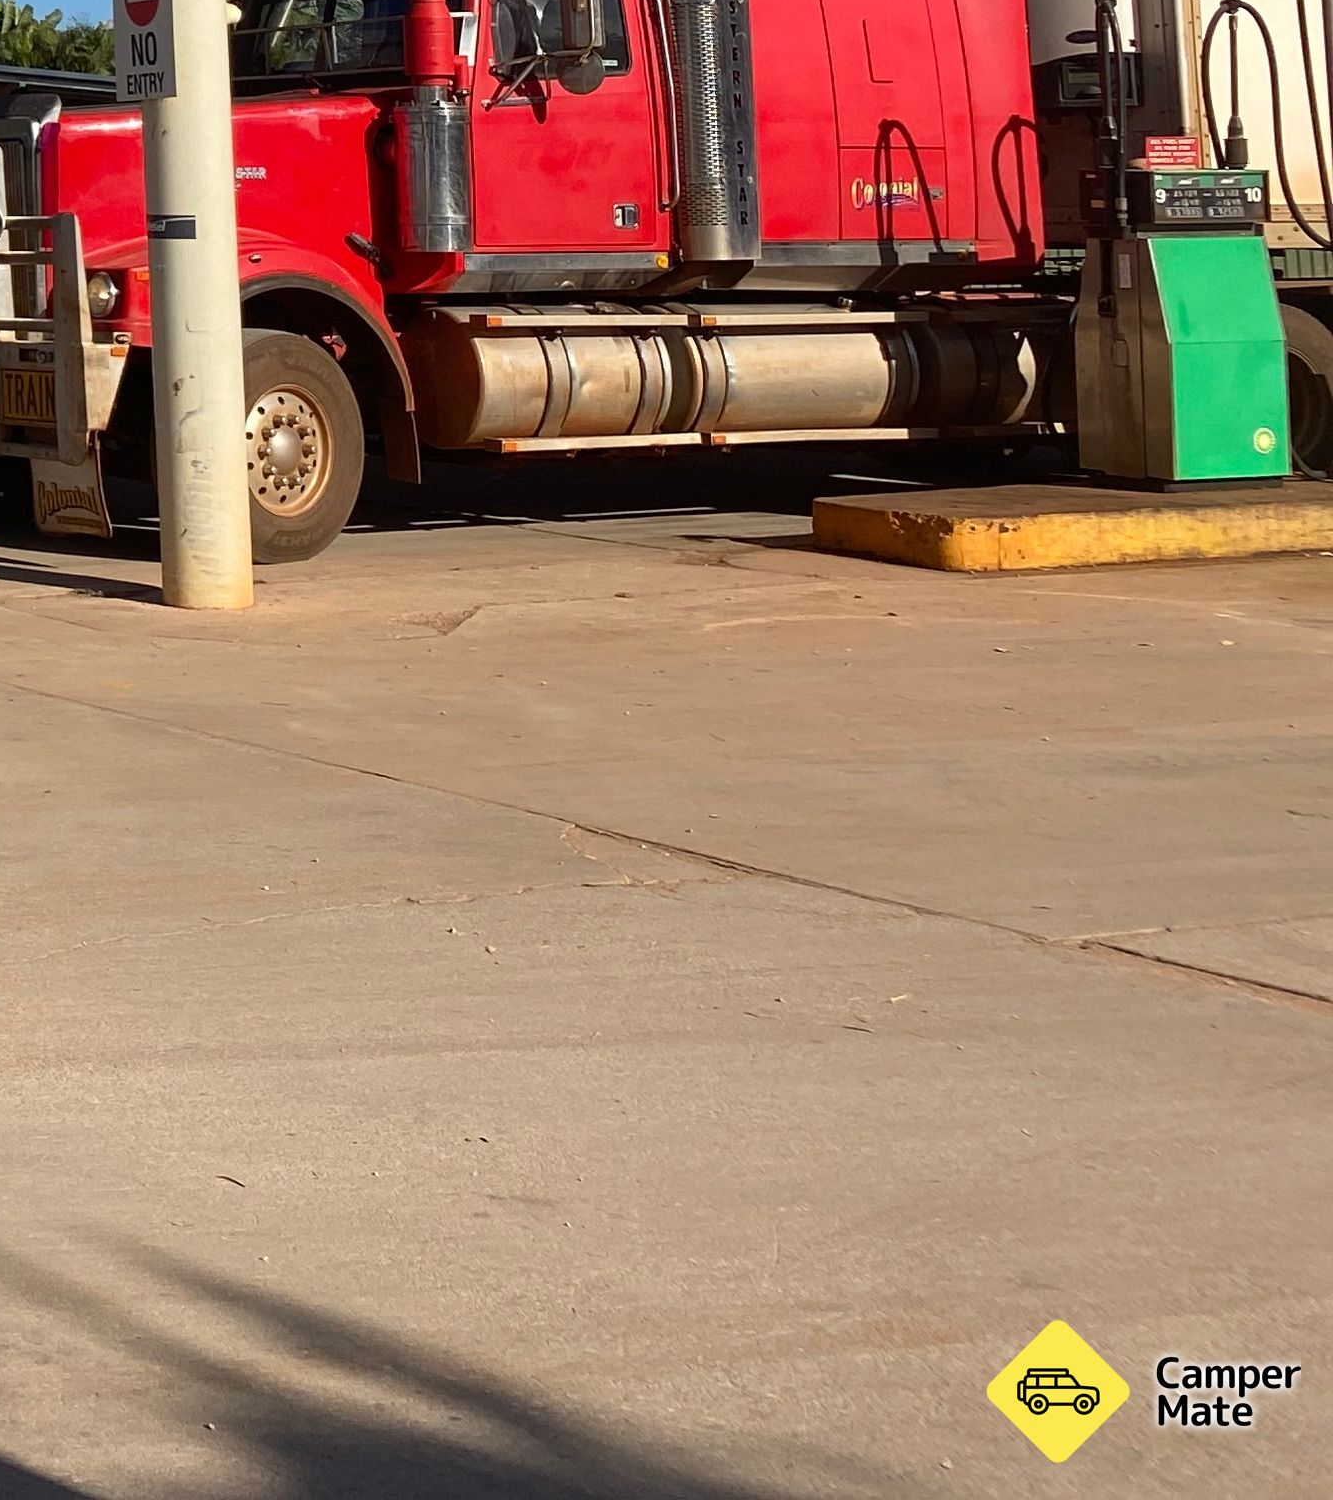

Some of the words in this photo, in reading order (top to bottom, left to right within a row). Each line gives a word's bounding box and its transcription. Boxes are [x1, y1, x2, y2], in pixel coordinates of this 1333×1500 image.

[131, 31, 157, 67] NO
[127, 72, 164, 96] ENTRY
[236, 166, 267, 179] STAR
[737, 140, 748, 225] STAR
[851, 177, 918, 209] Coonial
[1155, 188, 1166, 204] 9
[1245, 188, 1261, 202] 10
[5, 372, 55, 418] TRAIN
[37, 480, 100, 524] Colonial
